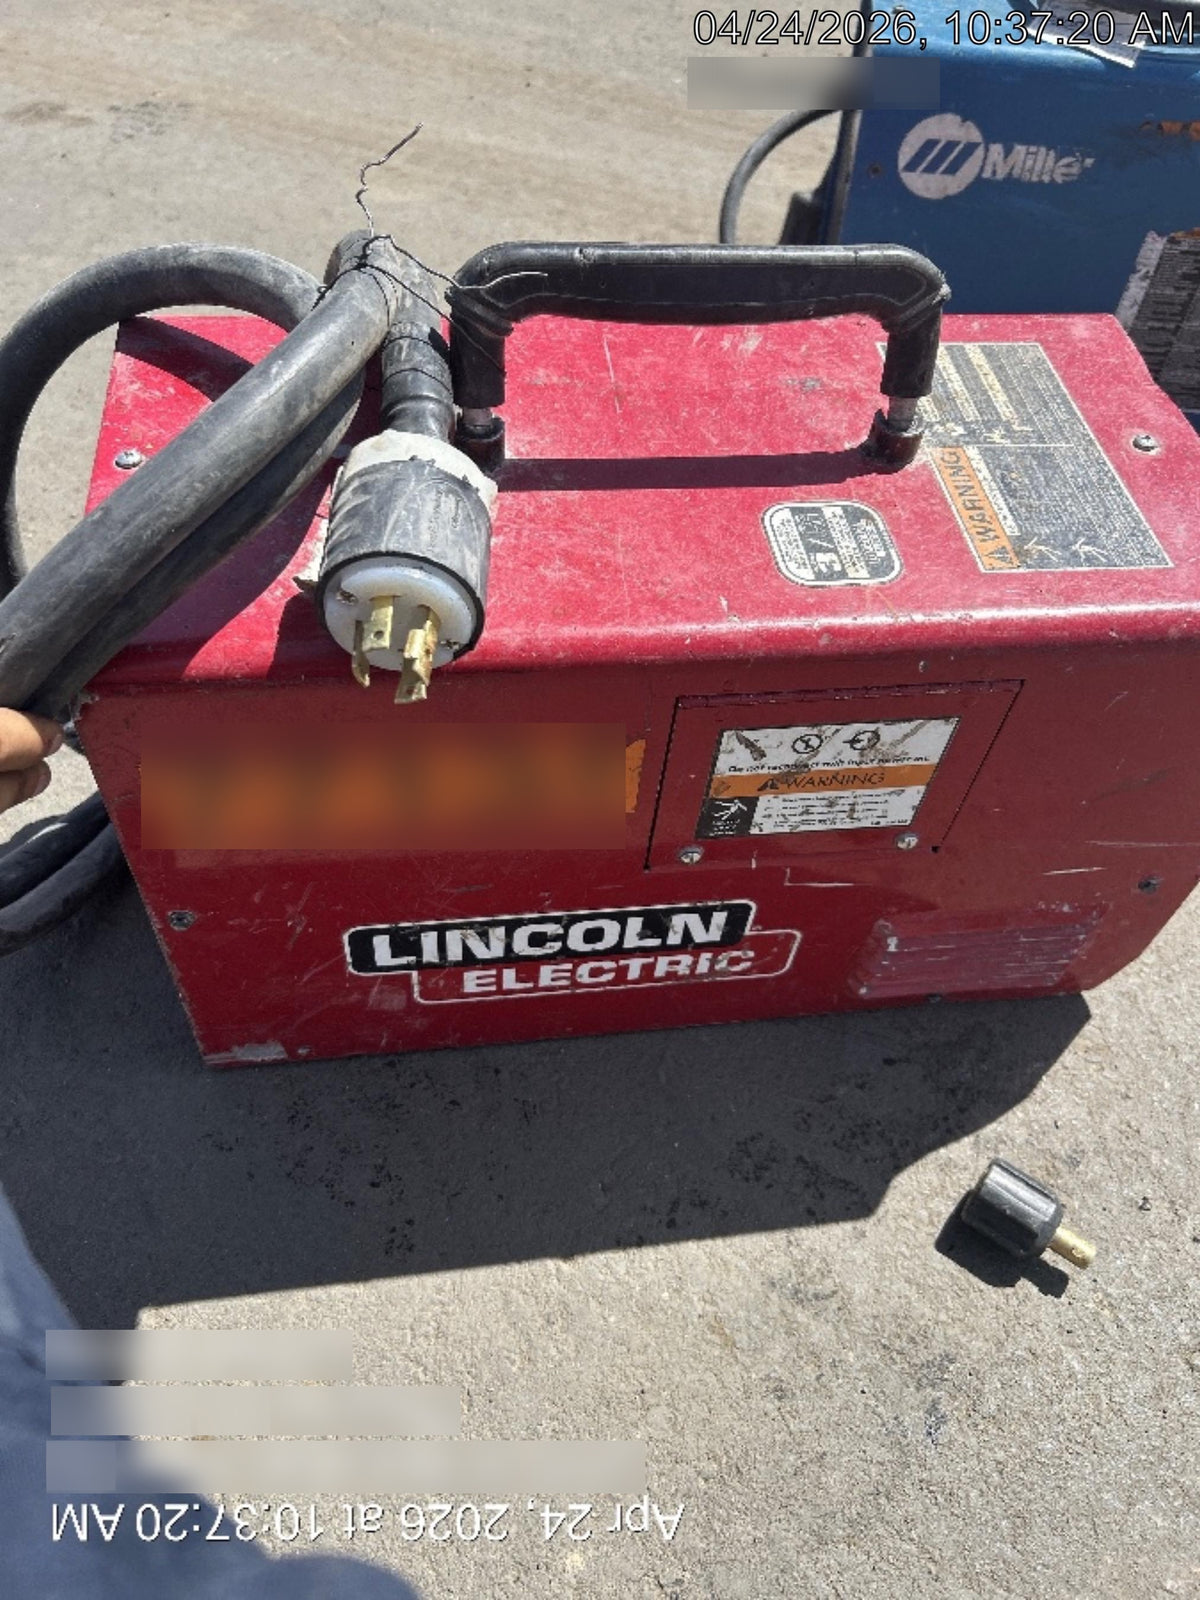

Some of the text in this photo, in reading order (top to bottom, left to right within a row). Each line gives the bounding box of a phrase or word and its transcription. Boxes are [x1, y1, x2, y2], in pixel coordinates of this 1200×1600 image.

[940, 450, 1000, 543] WARNING
[787, 771, 885, 790] WARNING
[372, 911, 728, 968] LINCOLN
[462, 949, 757, 995] ELECTRIC
